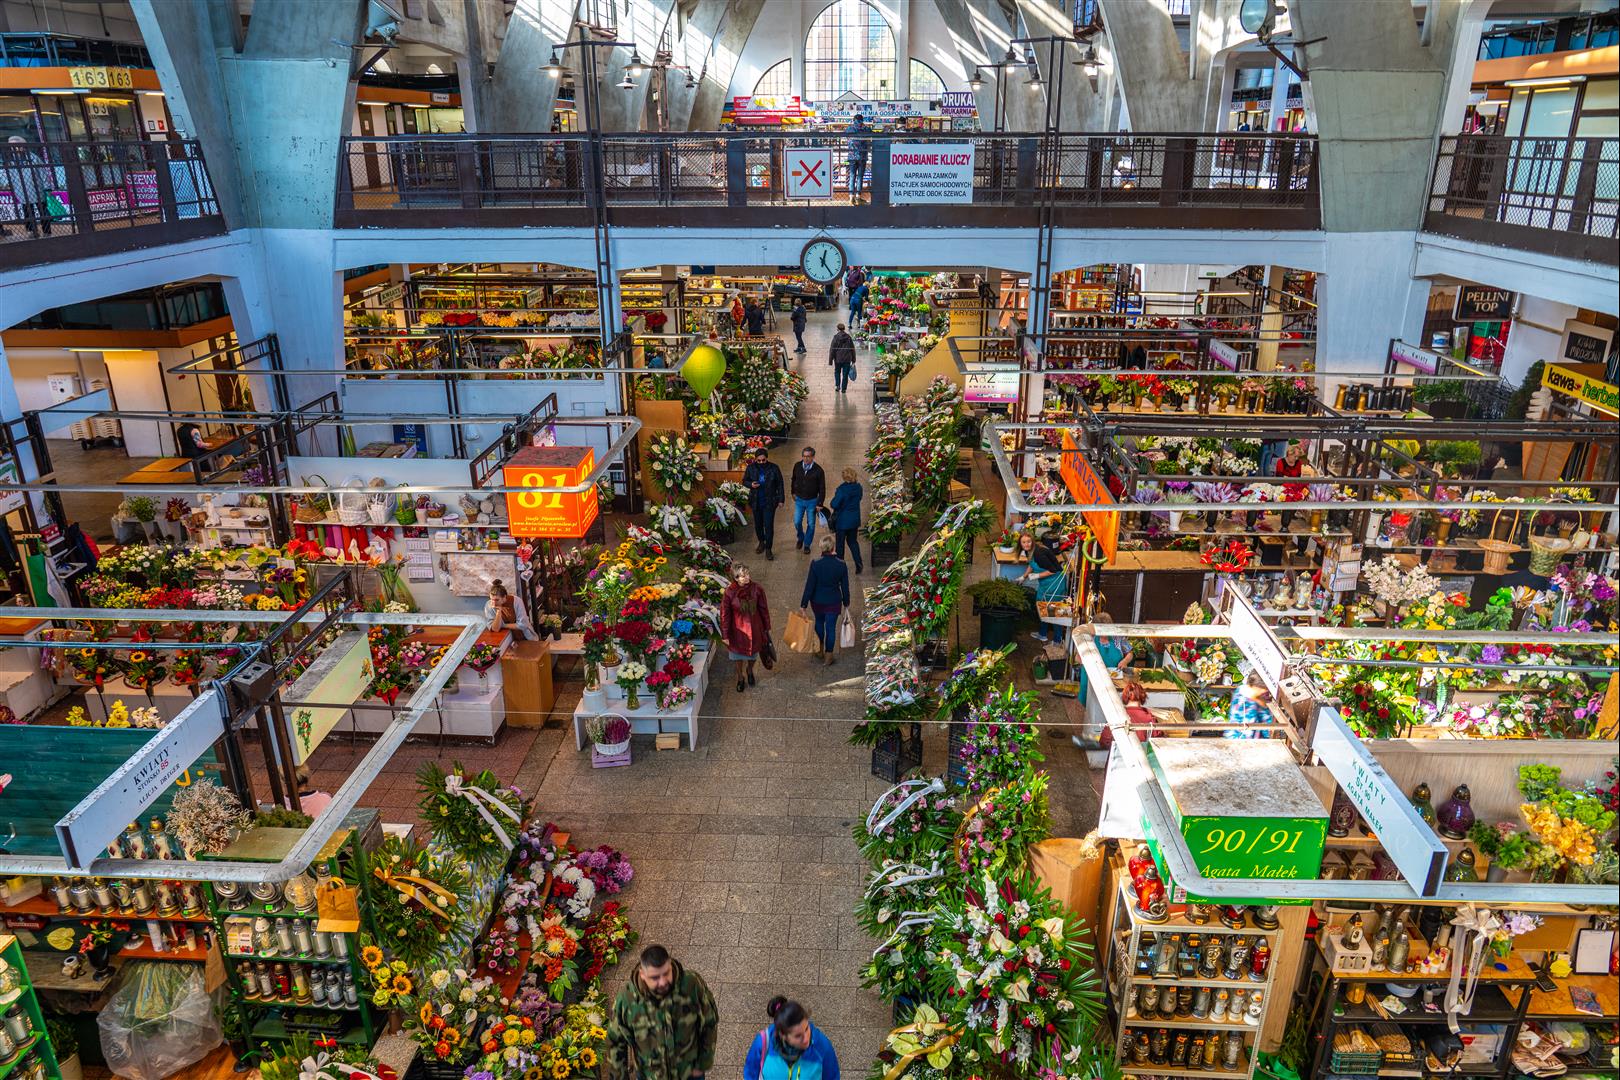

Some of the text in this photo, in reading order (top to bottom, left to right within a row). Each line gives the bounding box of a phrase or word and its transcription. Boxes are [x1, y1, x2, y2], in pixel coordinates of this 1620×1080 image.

[73, 71, 107, 85] 163
[109, 72, 131, 86] 163
[942, 93, 976, 107] DRUKA
[892, 153, 971, 166] DORABIANIE KLUCZY
[933, 171, 958, 179] ZAMKÓW
[1466, 292, 1509, 302] PELLINI
[1475, 302, 1498, 312] TOP
[1547, 367, 1574, 392] kawa
[517, 473, 566, 508] 81
[133, 747, 169, 785] KWIATY
[137, 770, 160, 793] STOISKO
[1352, 759, 1386, 805] KWIATY
[139, 785, 158, 807] ALICJA
[1347, 782, 1383, 834] AGATA MAŁEK
[1200, 827, 1303, 854] 90/91
[1200, 865, 1299, 879] Agata Małek
